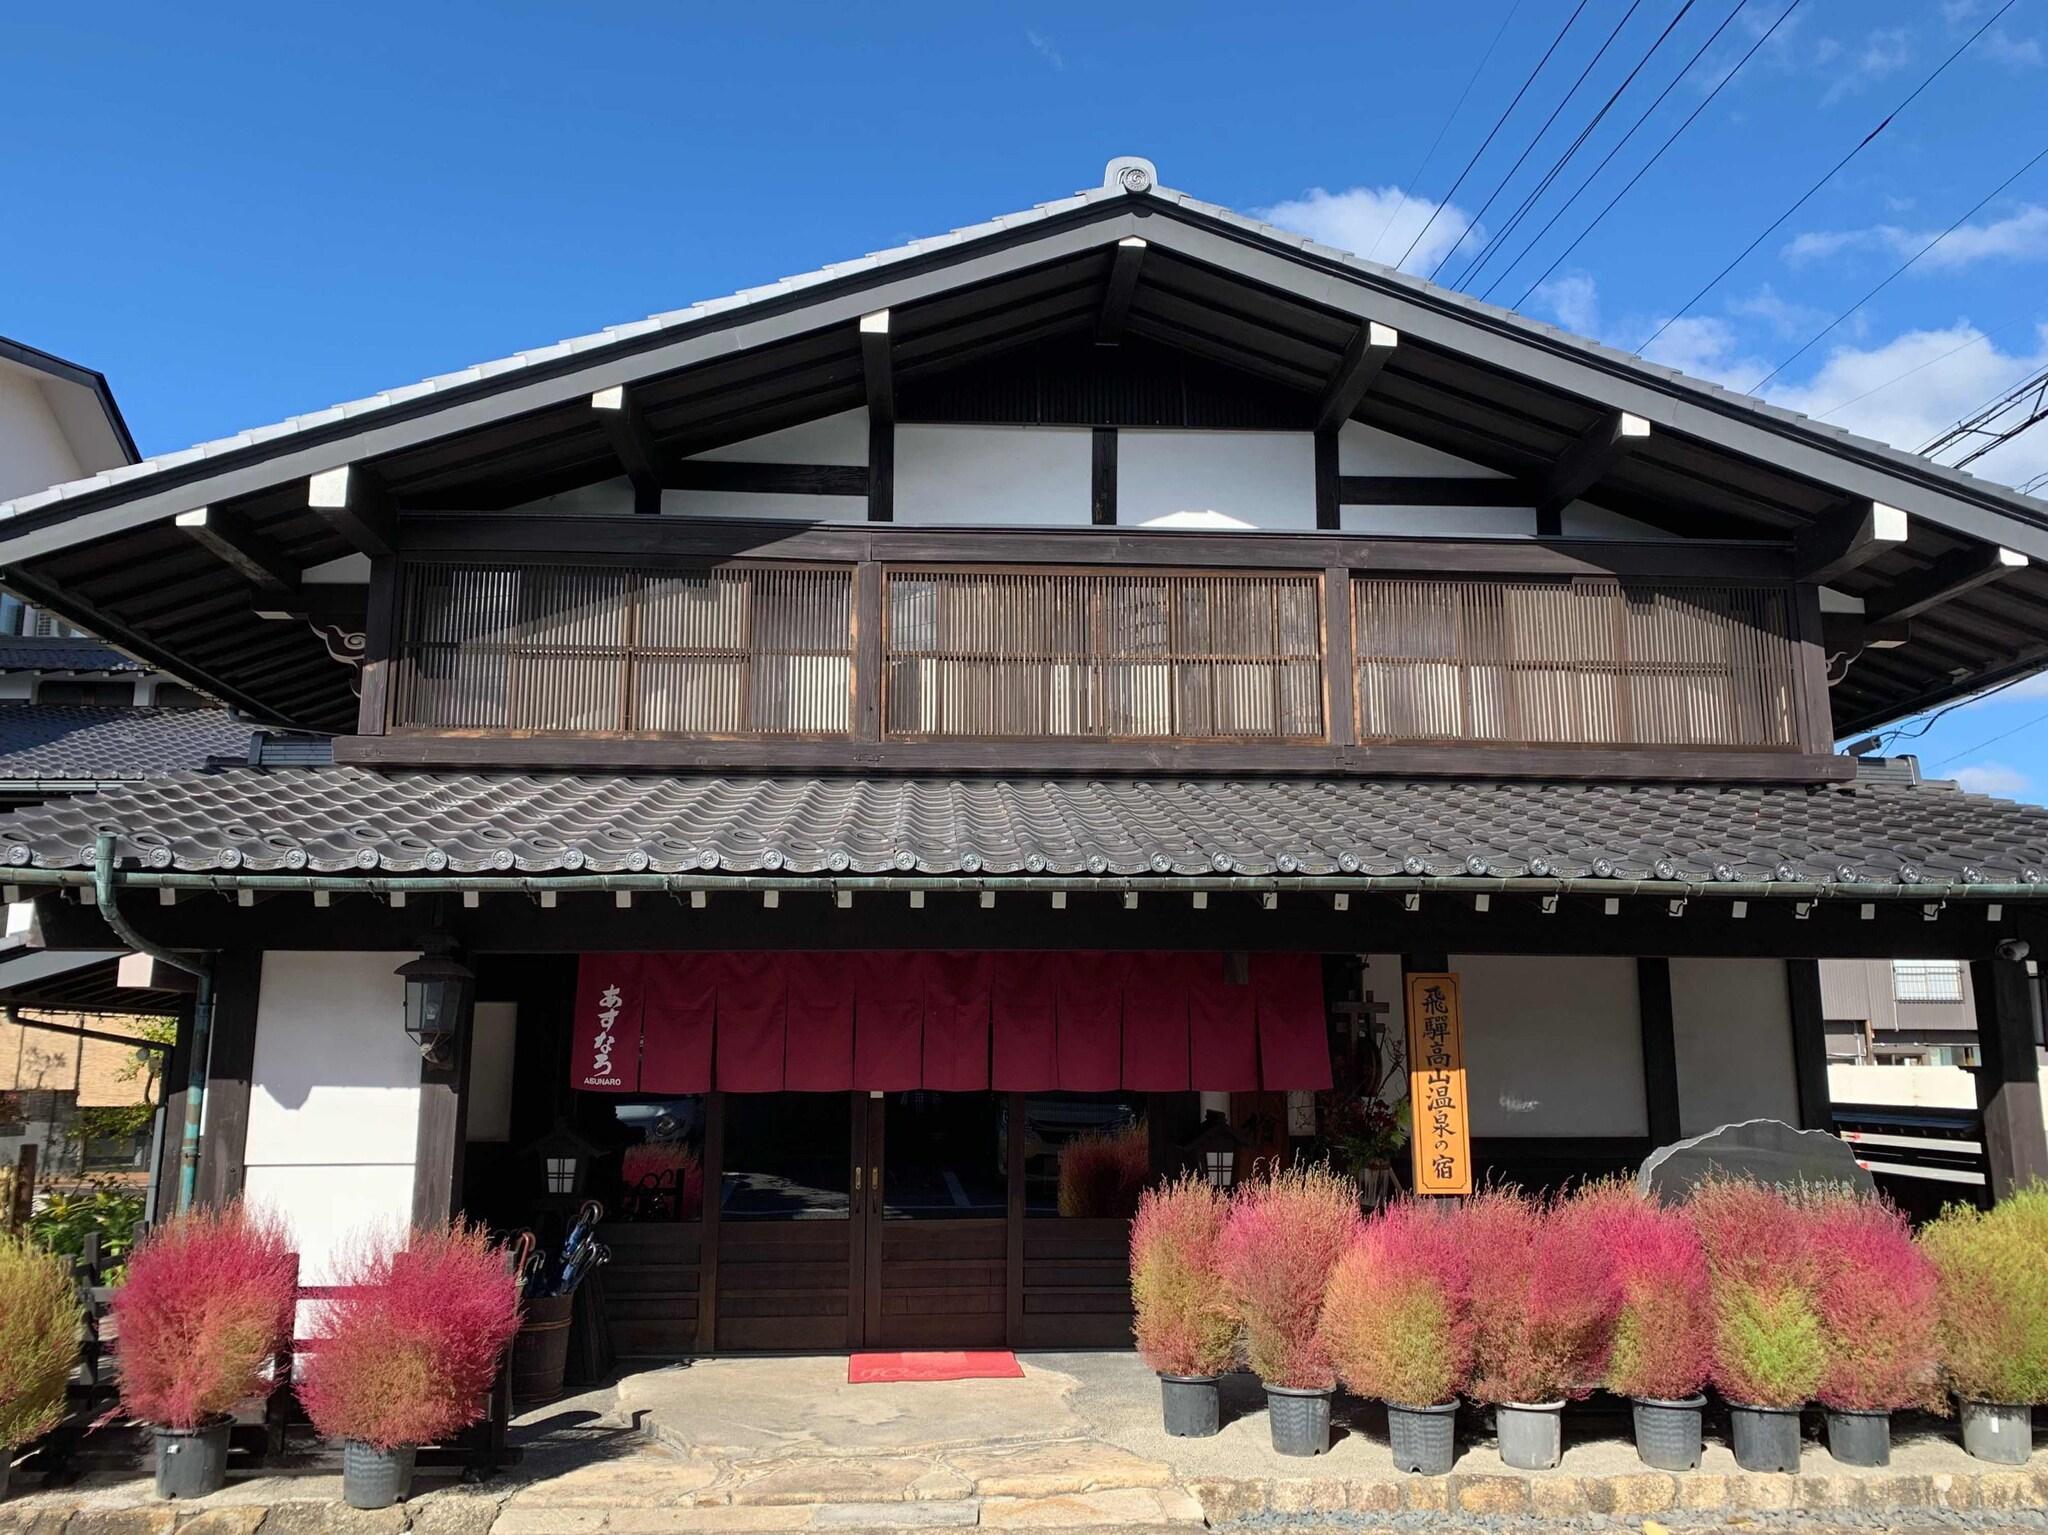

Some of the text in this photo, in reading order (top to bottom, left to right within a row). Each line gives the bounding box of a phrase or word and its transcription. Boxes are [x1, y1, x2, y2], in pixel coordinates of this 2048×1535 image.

[593, 984, 623, 1076] あすなろ
[584, 1077, 621, 1086] ASUNARO
